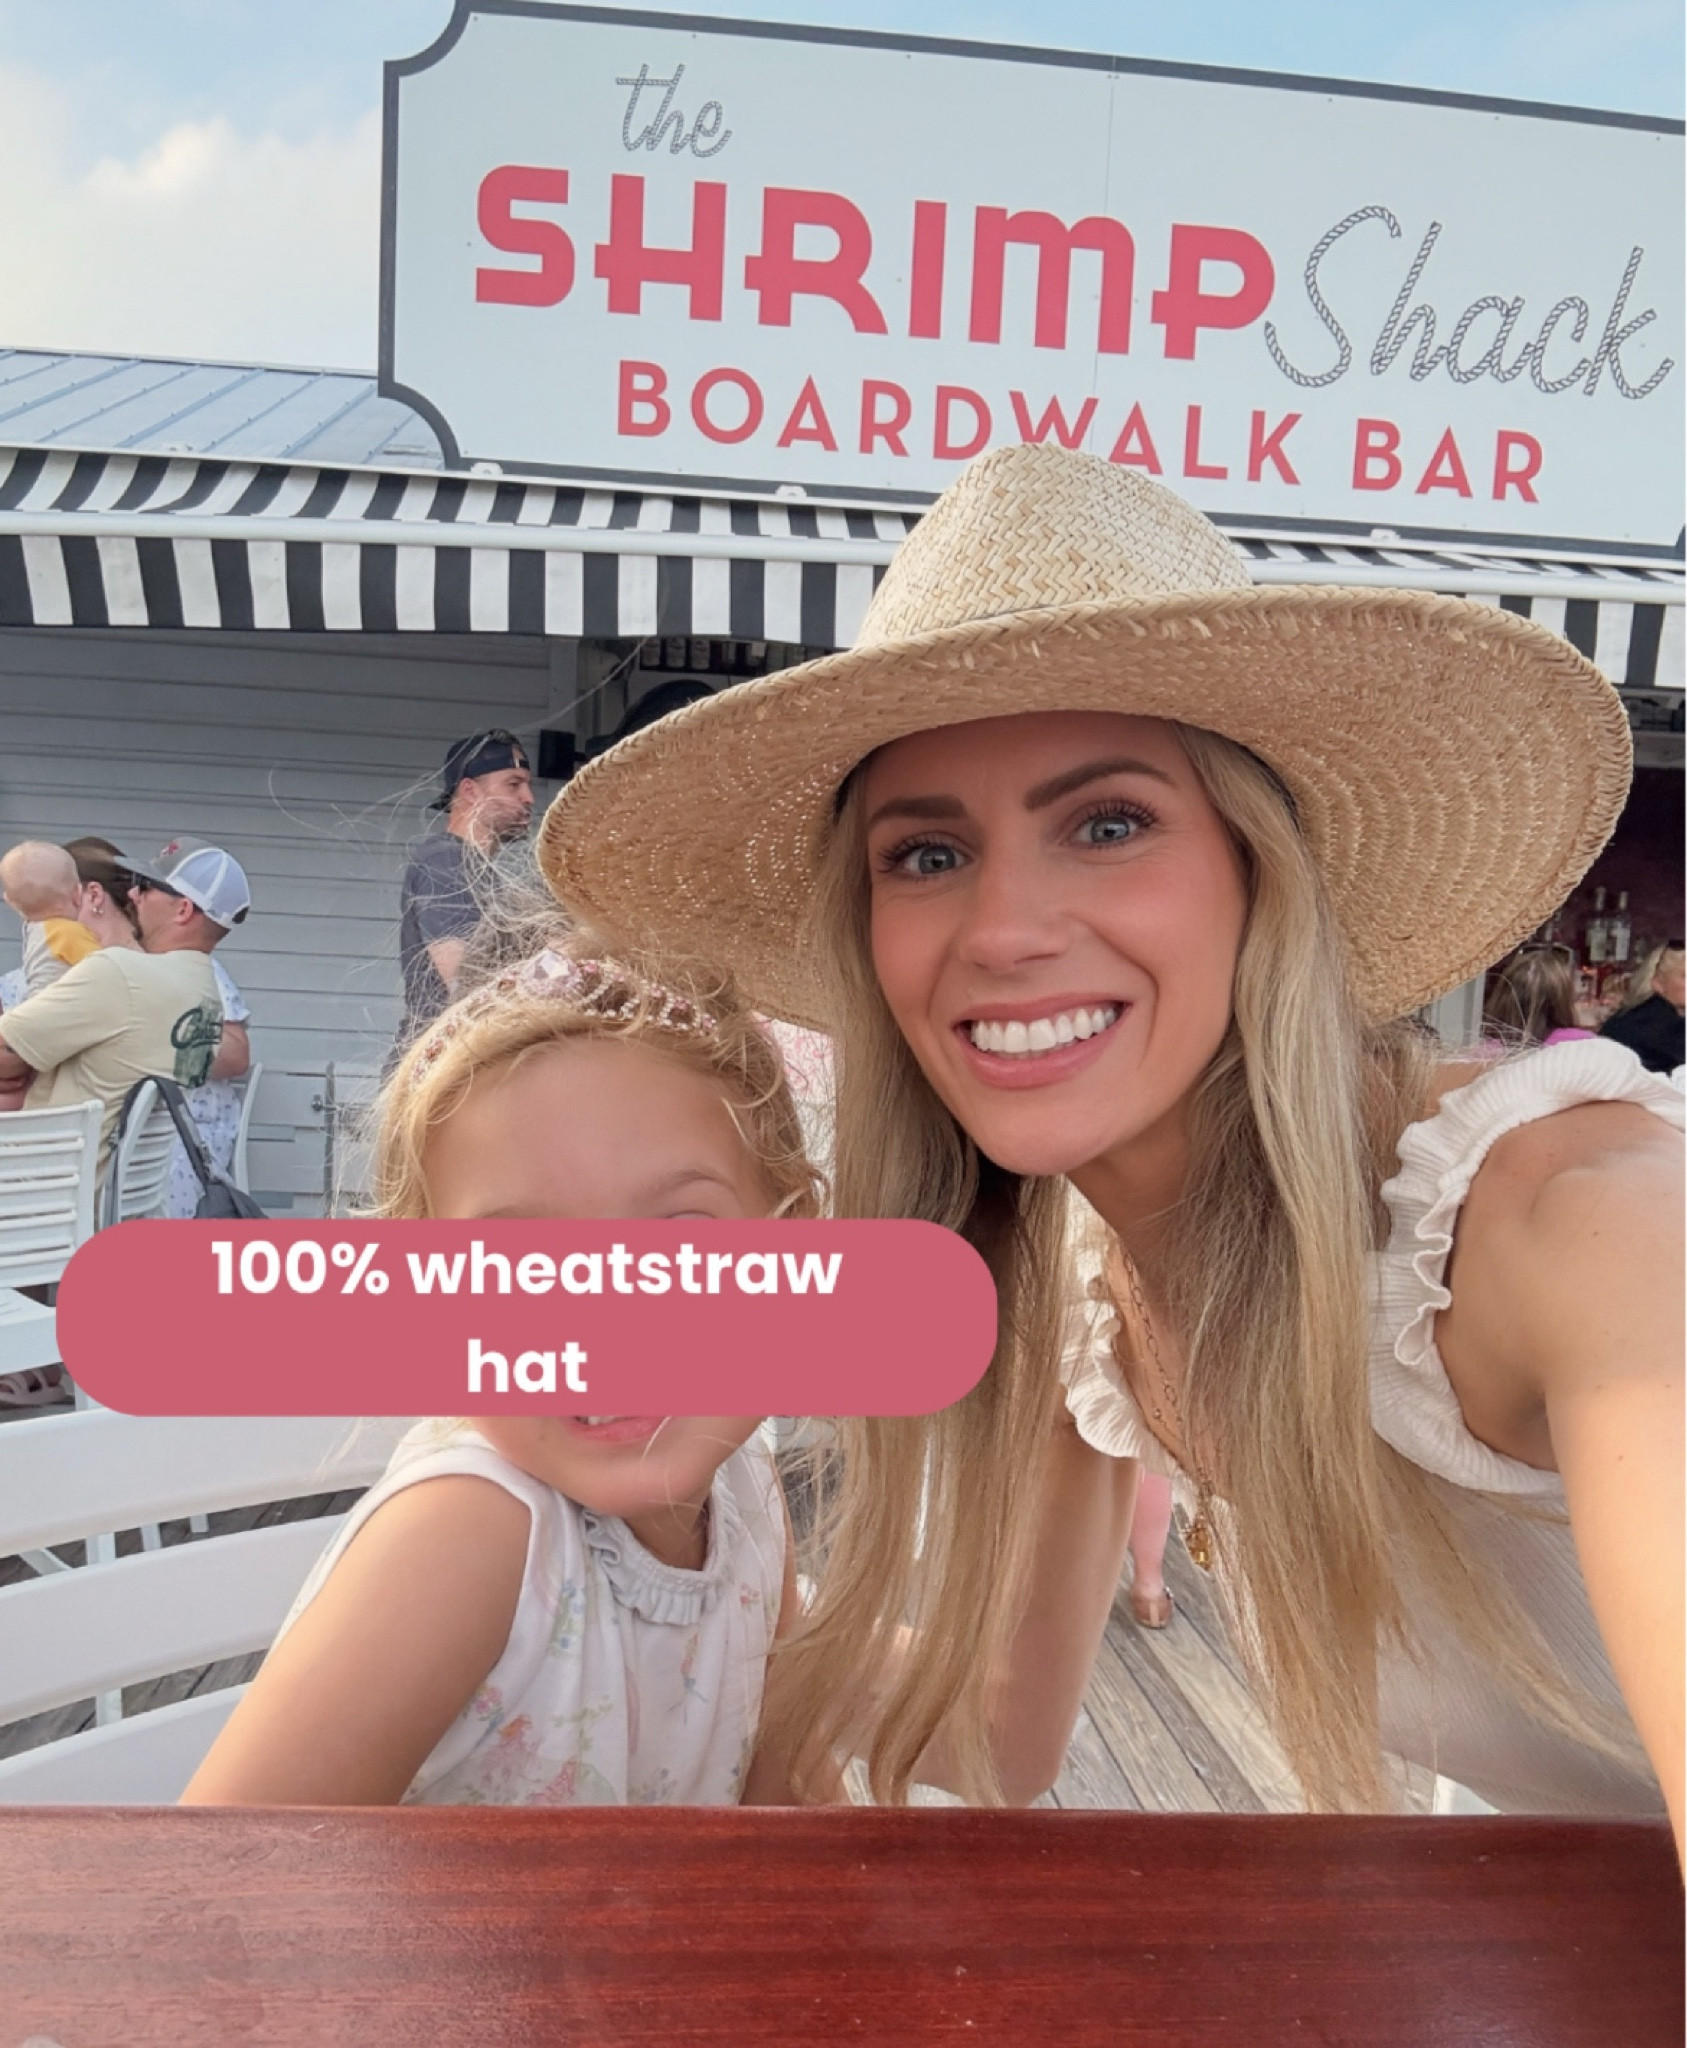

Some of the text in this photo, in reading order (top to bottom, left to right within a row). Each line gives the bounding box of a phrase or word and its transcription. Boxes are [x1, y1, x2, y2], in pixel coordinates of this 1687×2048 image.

[614, 63, 733, 158] the
[475, 164, 1675, 400] SHRIMP Shack
[616, 359, 1544, 503] BOARDWALK BAR
